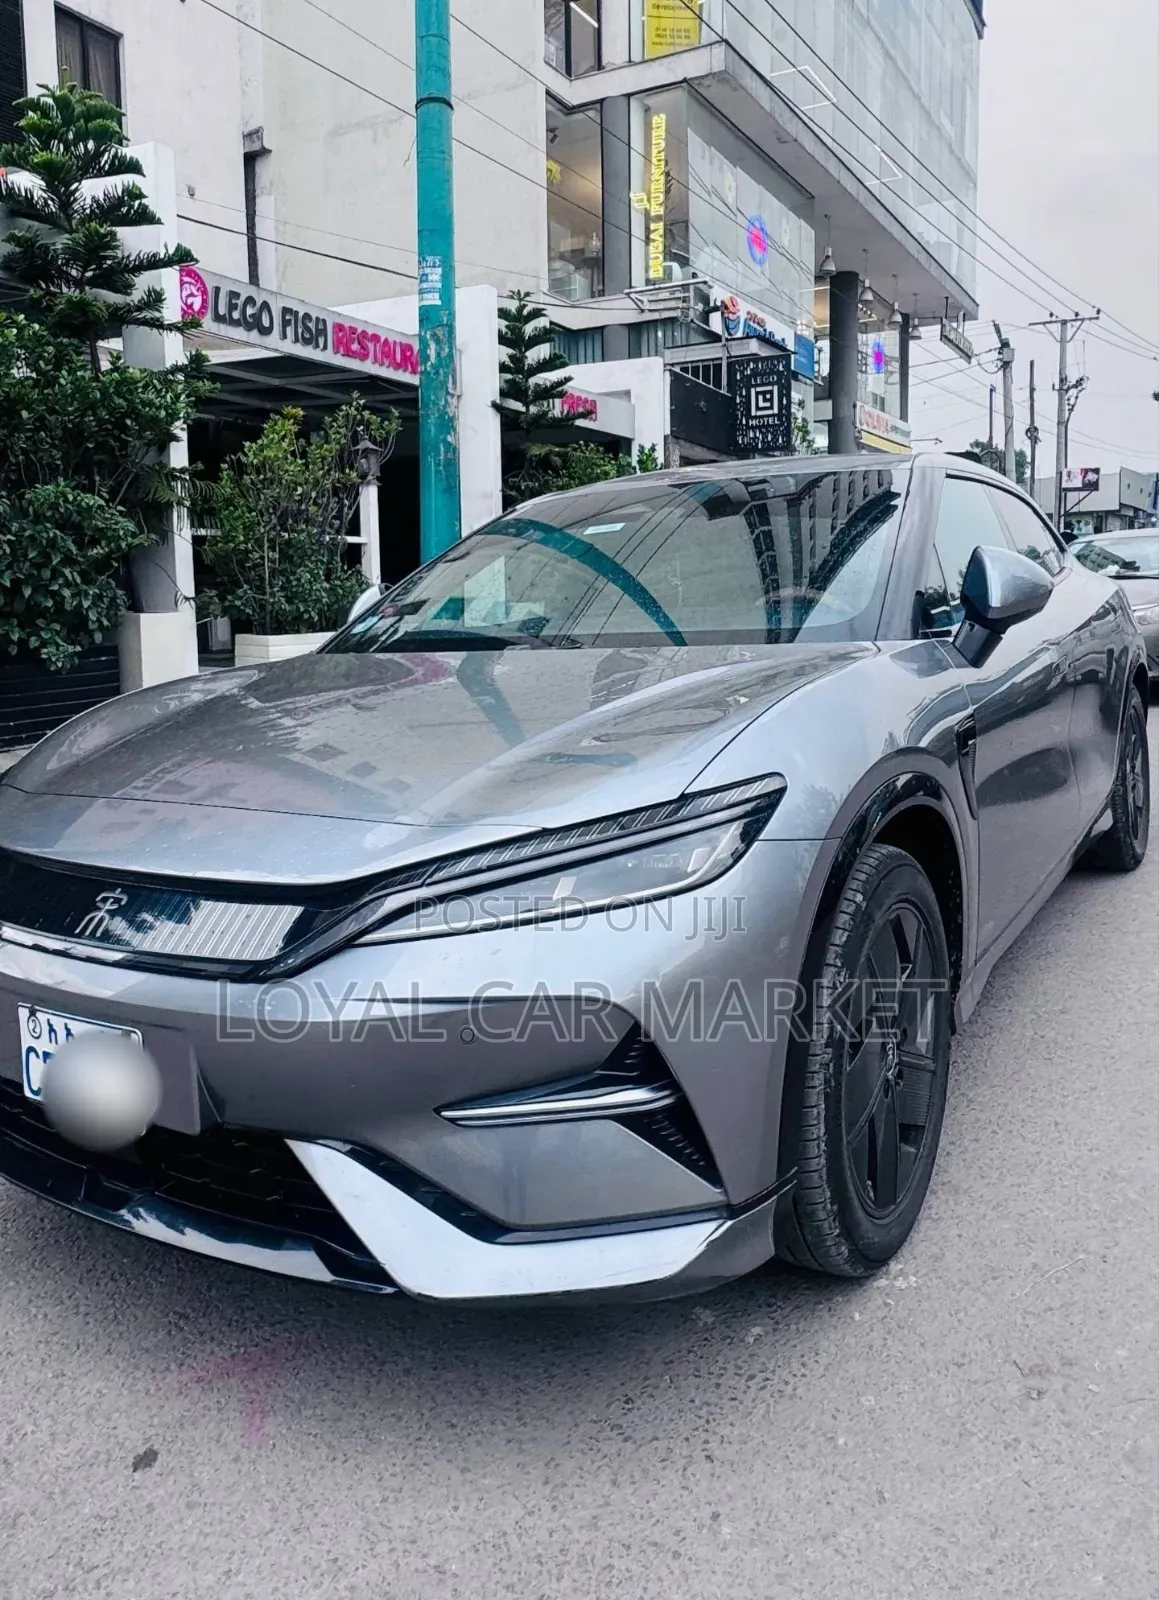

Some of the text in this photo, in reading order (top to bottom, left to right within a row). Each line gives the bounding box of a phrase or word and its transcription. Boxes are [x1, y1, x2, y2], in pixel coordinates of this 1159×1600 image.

[649, 112, 667, 279] DUBAI FURNITURE
[211, 285, 419, 375] LEGO FISH RESTAUR
[751, 374, 778, 385] LEGO
[748, 416, 780, 427] HOTEL
